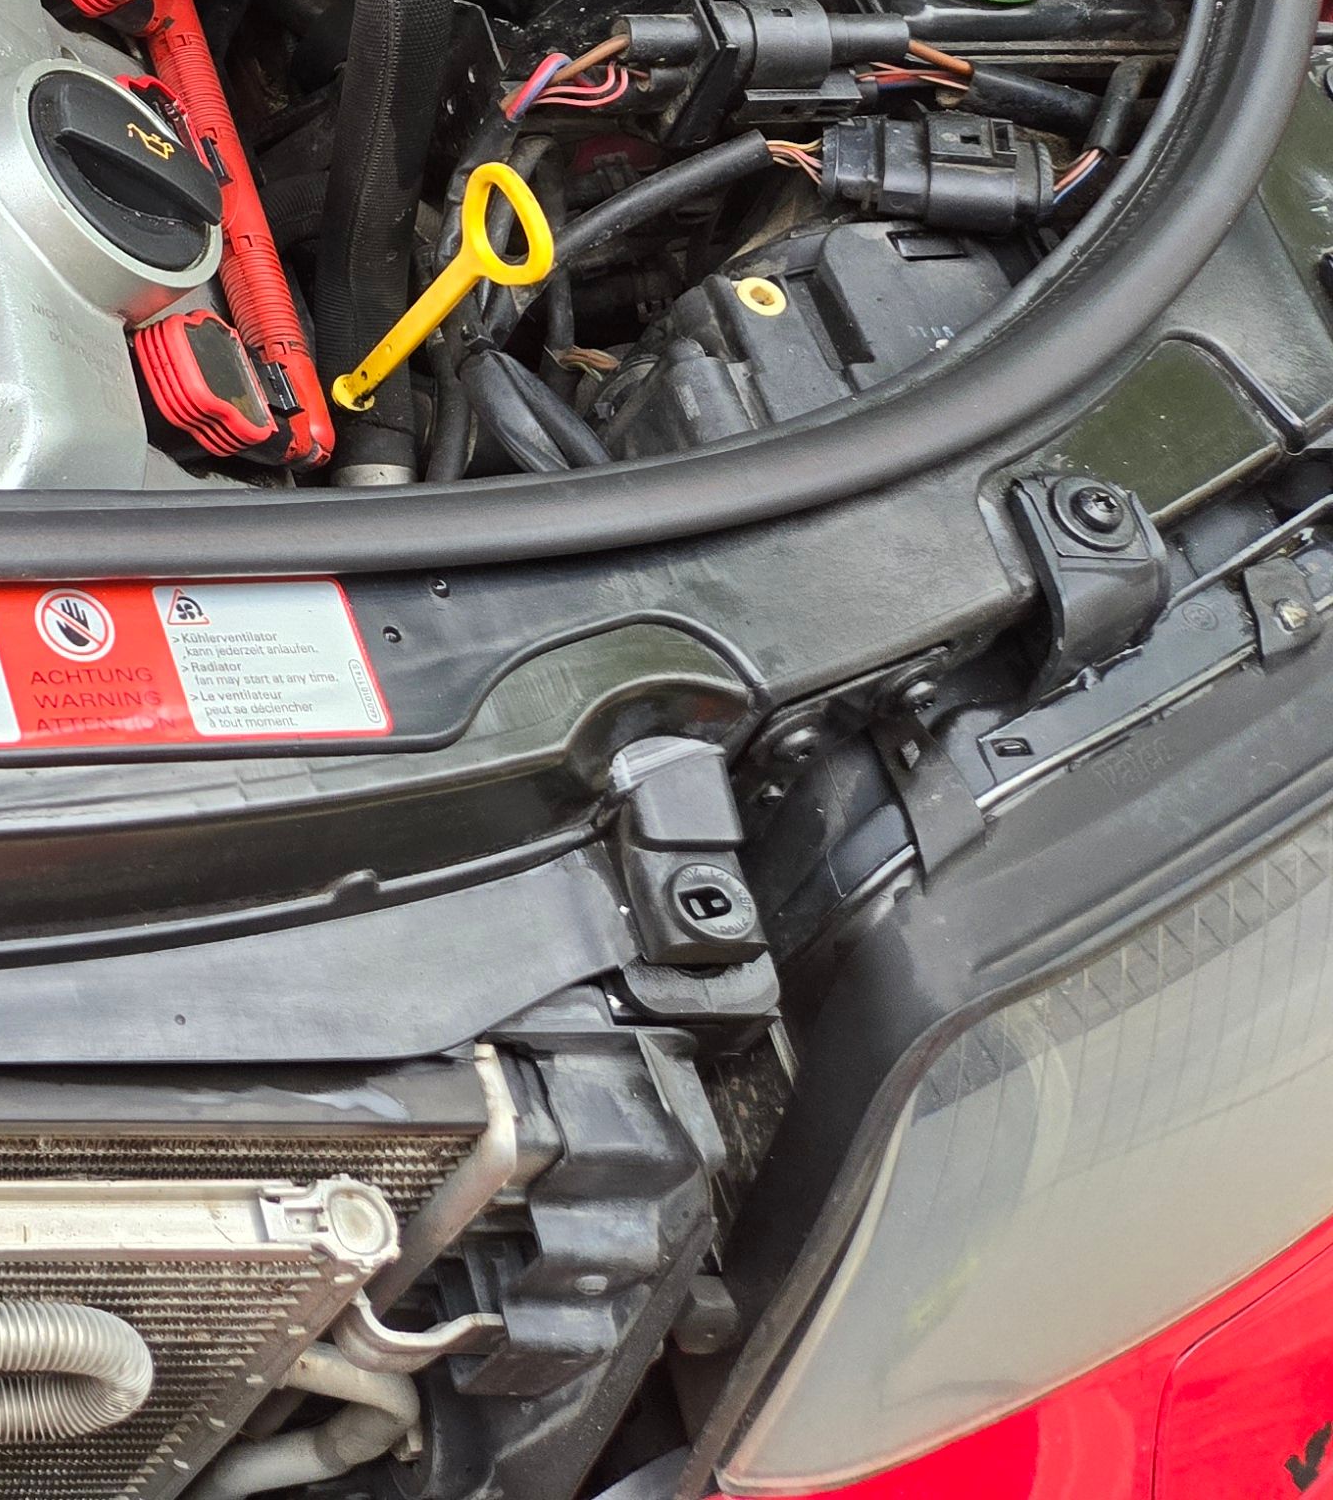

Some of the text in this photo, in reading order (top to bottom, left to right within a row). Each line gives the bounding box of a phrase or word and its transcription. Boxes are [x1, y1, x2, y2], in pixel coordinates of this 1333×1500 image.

[182, 631, 278, 644] Kühlerventilator
[186, 643, 318, 658] kann jederzeit anlaufen.
[191, 661, 242, 673] Radiator
[31, 667, 153, 685] ACHTUNG
[195, 671, 339, 687] fan may start at any time.
[33, 690, 164, 709] WARNING
[199, 689, 282, 702] Le ventilateur
[205, 702, 313, 717] peut se déclencher
[219, 717, 242, 728] tout
[245, 716, 298, 728] moment.
